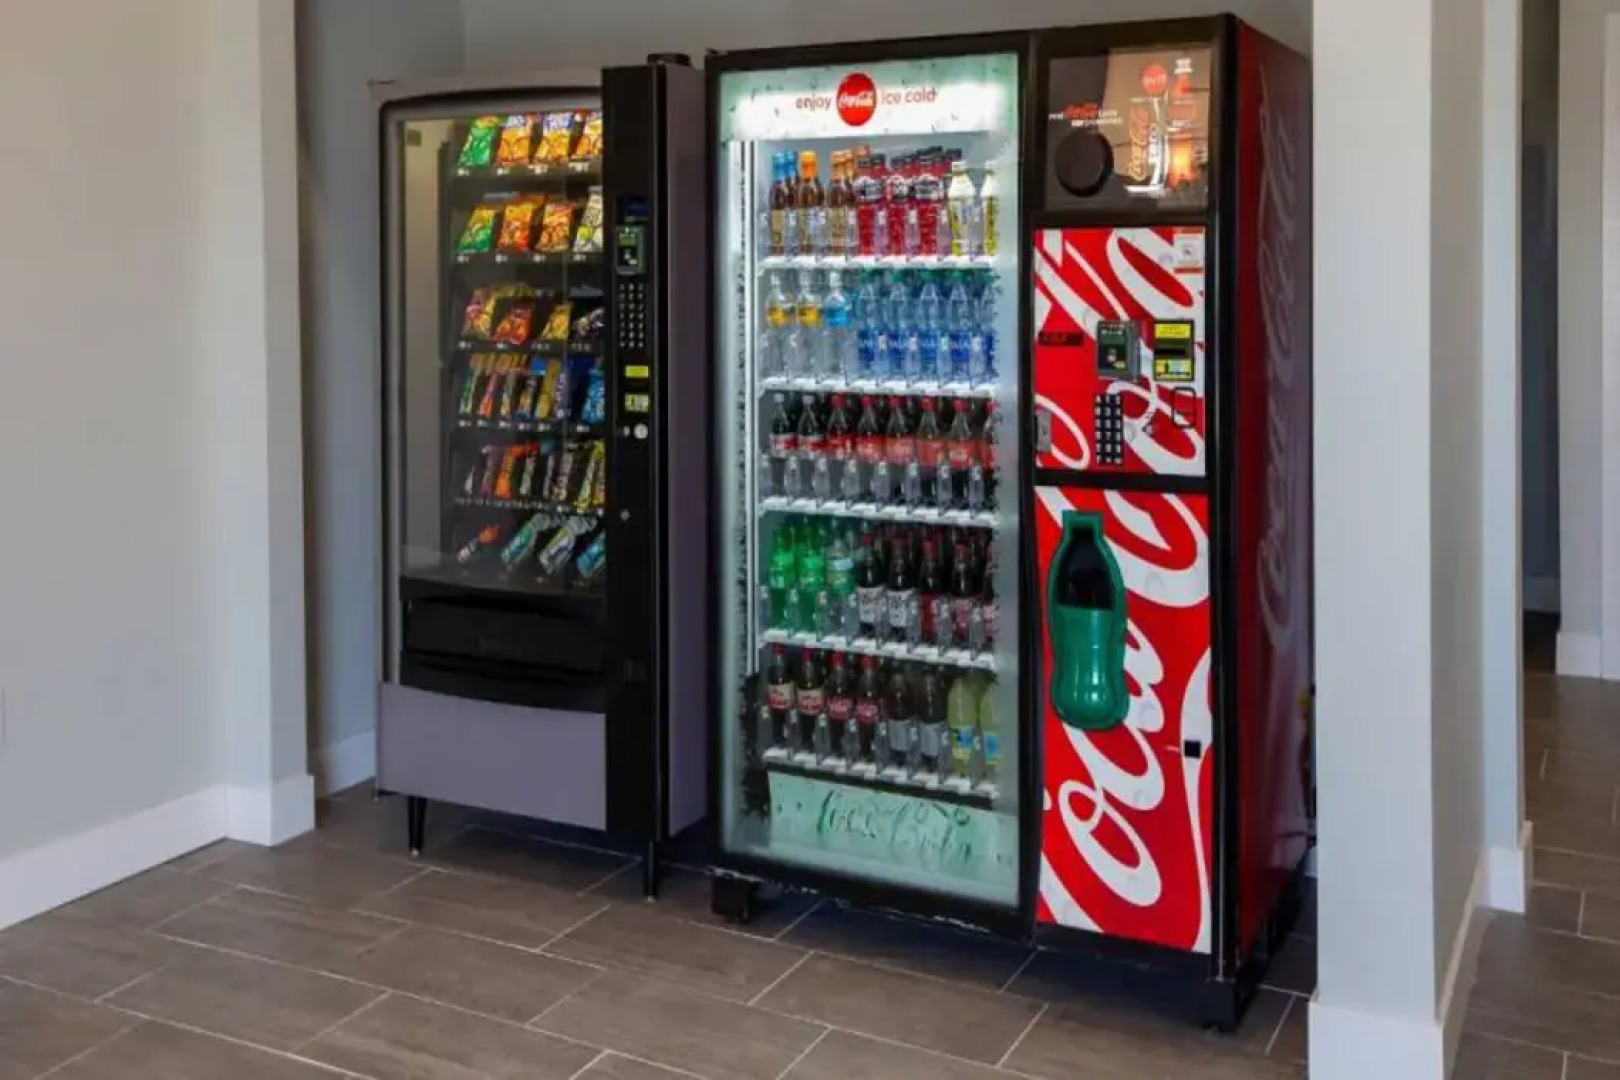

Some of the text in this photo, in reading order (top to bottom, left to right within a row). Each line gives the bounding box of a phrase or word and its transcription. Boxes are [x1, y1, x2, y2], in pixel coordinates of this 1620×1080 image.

[796, 92, 832, 112] enjoy
[881, 89, 901, 106] ice
[906, 86, 937, 104] cold
